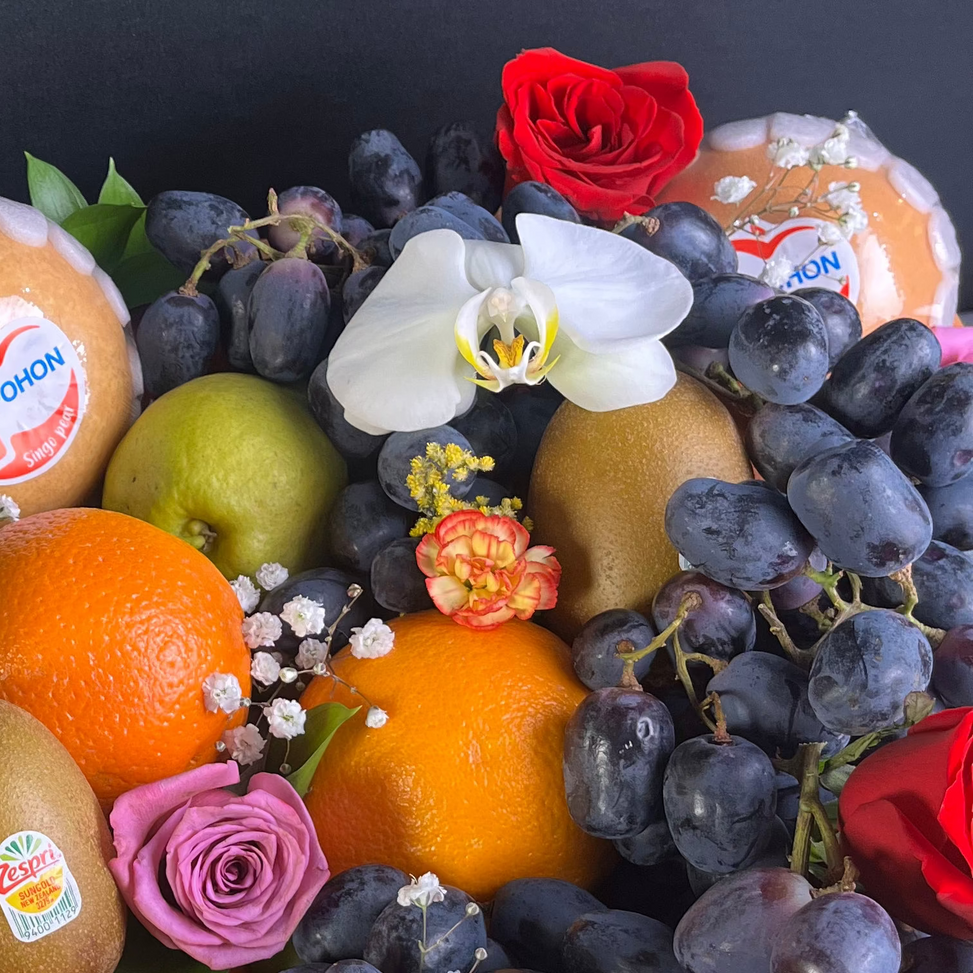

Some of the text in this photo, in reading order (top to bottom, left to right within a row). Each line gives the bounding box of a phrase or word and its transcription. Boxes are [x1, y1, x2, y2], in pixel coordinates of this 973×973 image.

[23, 404, 76, 468] Singo pear
[18, 876, 56, 901] SUNGOLD
[20, 897, 35, 909] NEW
[24, 905, 76, 940] 9400 1129
